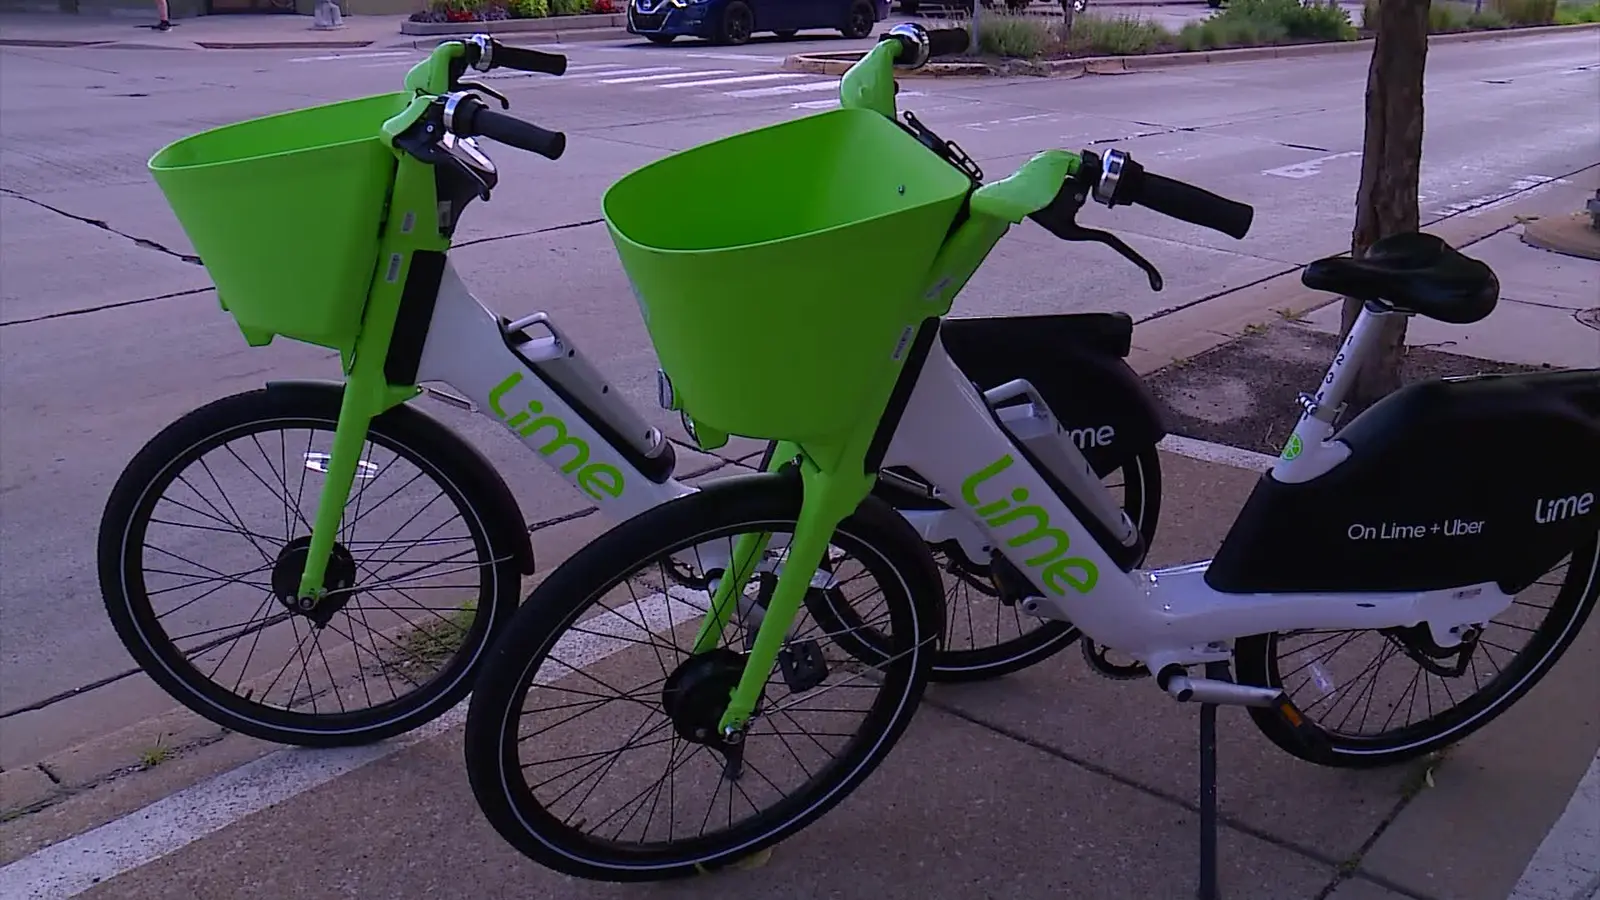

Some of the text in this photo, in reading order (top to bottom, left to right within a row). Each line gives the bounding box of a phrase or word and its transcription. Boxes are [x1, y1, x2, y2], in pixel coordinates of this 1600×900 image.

[1347, 335, 1354, 346] 1
[1336, 353, 1345, 366] 2
[1325, 371, 1334, 384] 3
[488, 371, 625, 501] Lime
[1066, 425, 1115, 449] me
[1535, 492, 1594, 524] Lime
[961, 454, 1099, 596] Lime
[1347, 519, 1486, 540] On Lime + Uber
